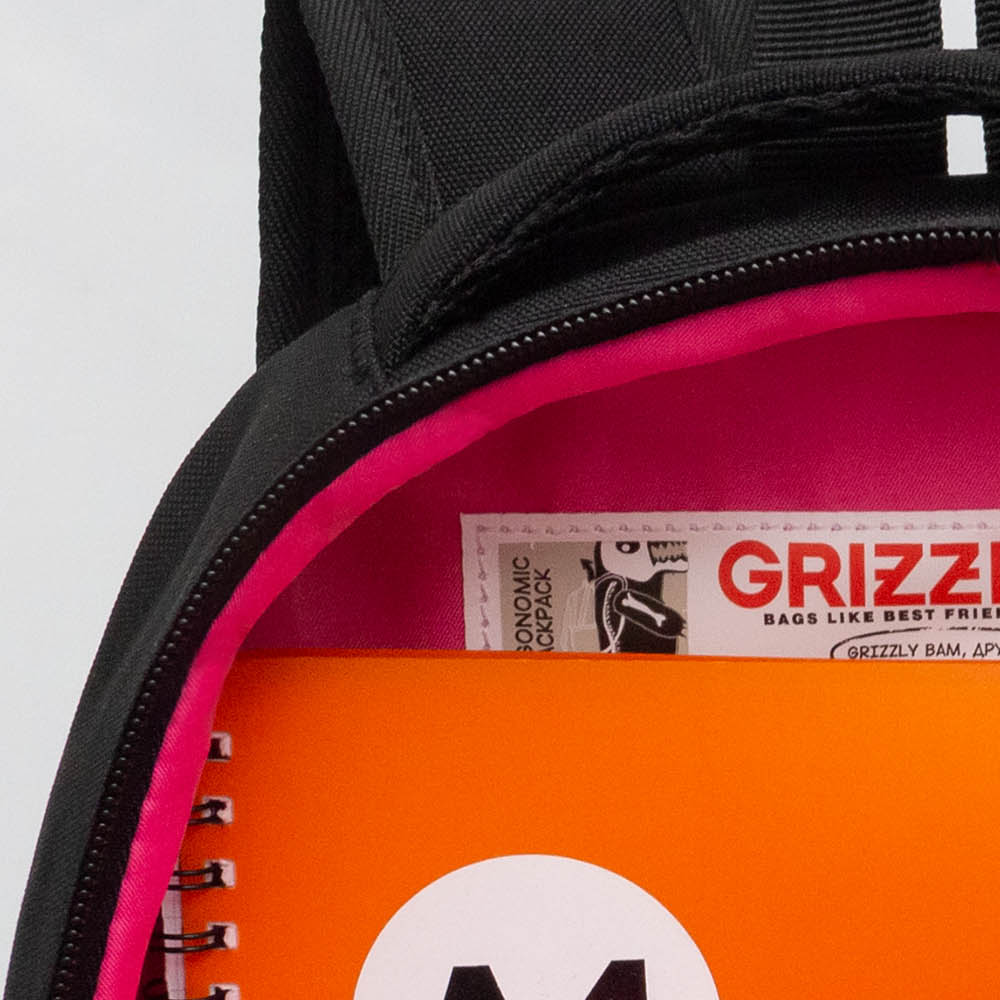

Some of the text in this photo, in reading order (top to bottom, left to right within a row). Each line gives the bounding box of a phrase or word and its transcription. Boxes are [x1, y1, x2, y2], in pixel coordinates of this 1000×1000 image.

[534, 568, 555, 652] CKPACK
[763, 613, 818, 625] BAGS
[827, 611, 874, 624] LIKE
[883, 609, 935, 621] BEST
[847, 643, 918, 659] GRIZZLY
[925, 642, 967, 658] ВАМ,
